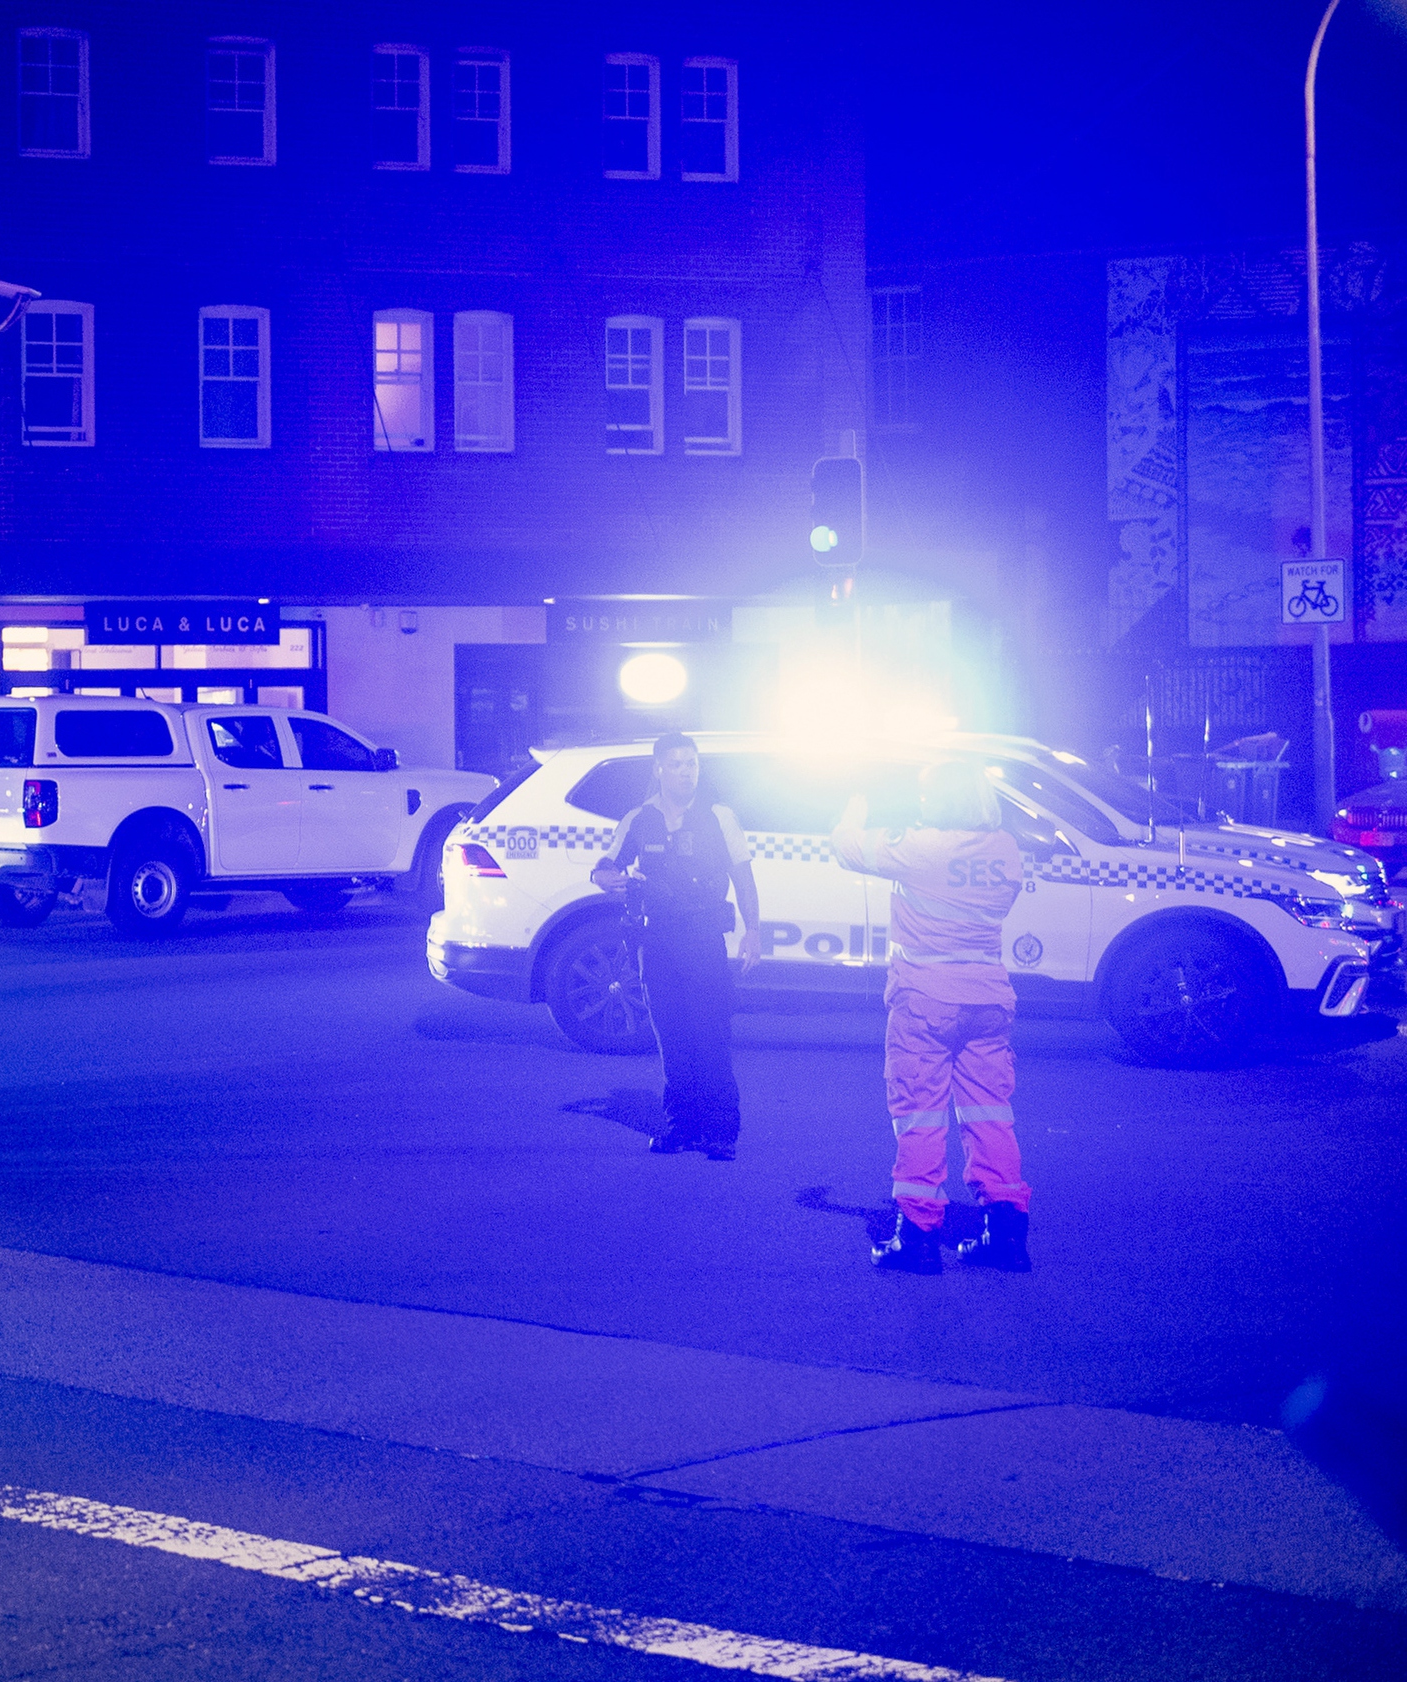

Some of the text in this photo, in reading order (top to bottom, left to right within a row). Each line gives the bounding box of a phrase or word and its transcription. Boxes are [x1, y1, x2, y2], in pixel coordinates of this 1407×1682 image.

[1287, 564, 1338, 576] WATCH FOR
[103, 616, 266, 632] LUCA & LUCA
[565, 616, 719, 631] SUSHI TRAIN
[507, 836, 537, 851] 000
[946, 859, 1008, 888] SES
